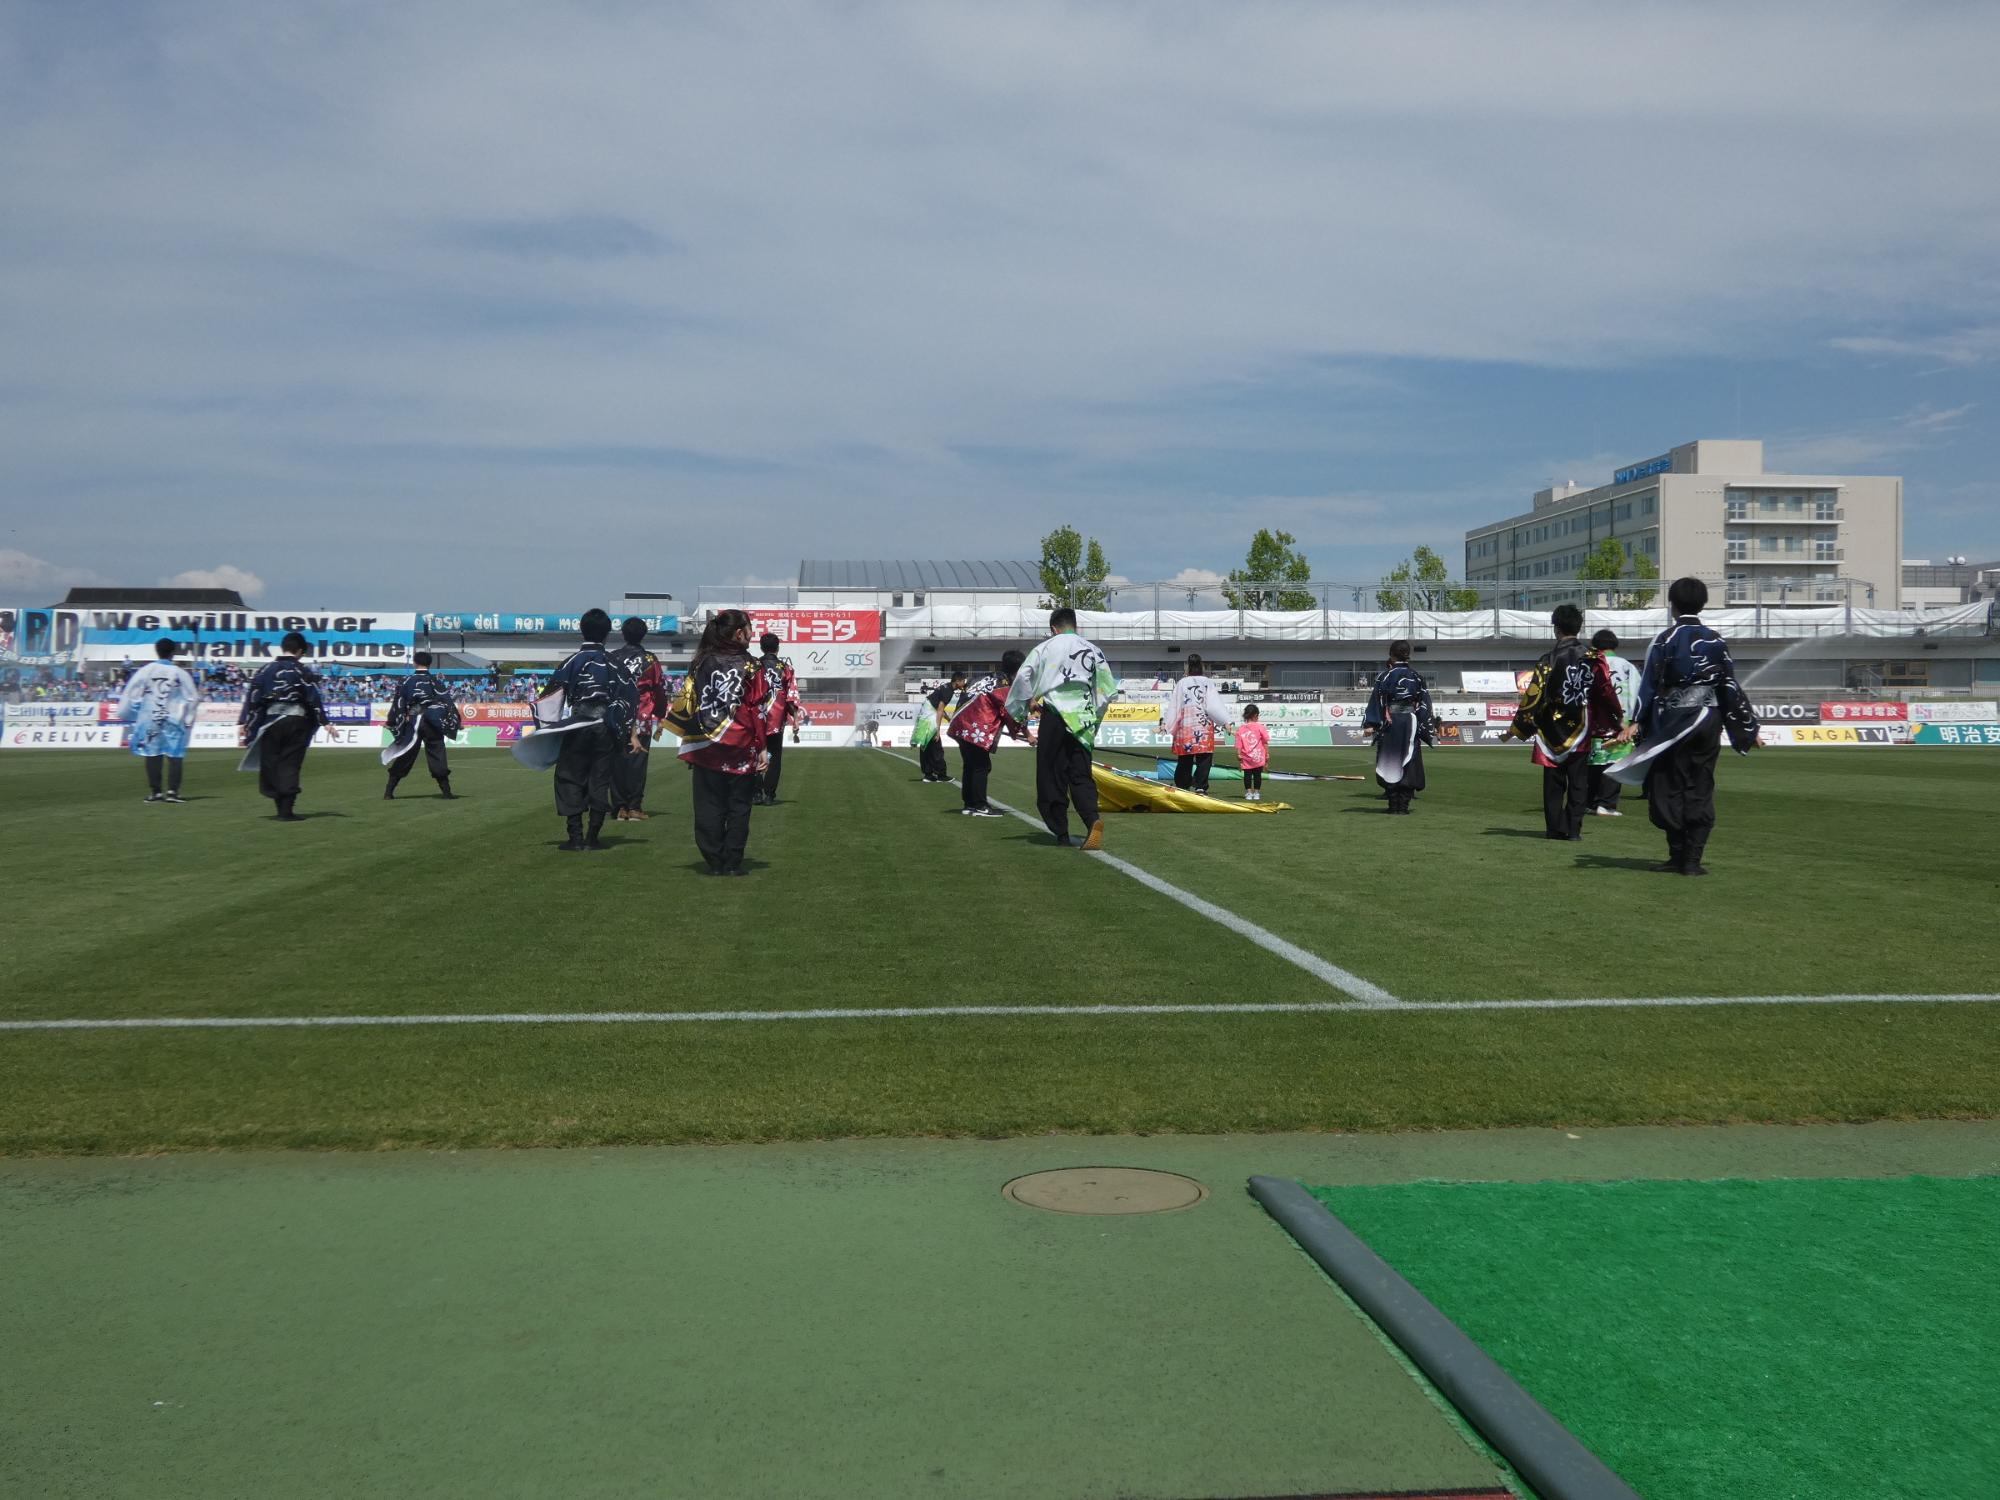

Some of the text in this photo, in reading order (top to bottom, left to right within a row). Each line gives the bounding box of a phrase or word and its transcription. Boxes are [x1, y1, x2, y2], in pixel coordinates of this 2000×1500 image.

[94, 612, 377, 633] We will never
[32, 731, 110, 743] RELIVE
[1795, 729, 1853, 741] SAGA
[1858, 729, 1885, 740] TV
